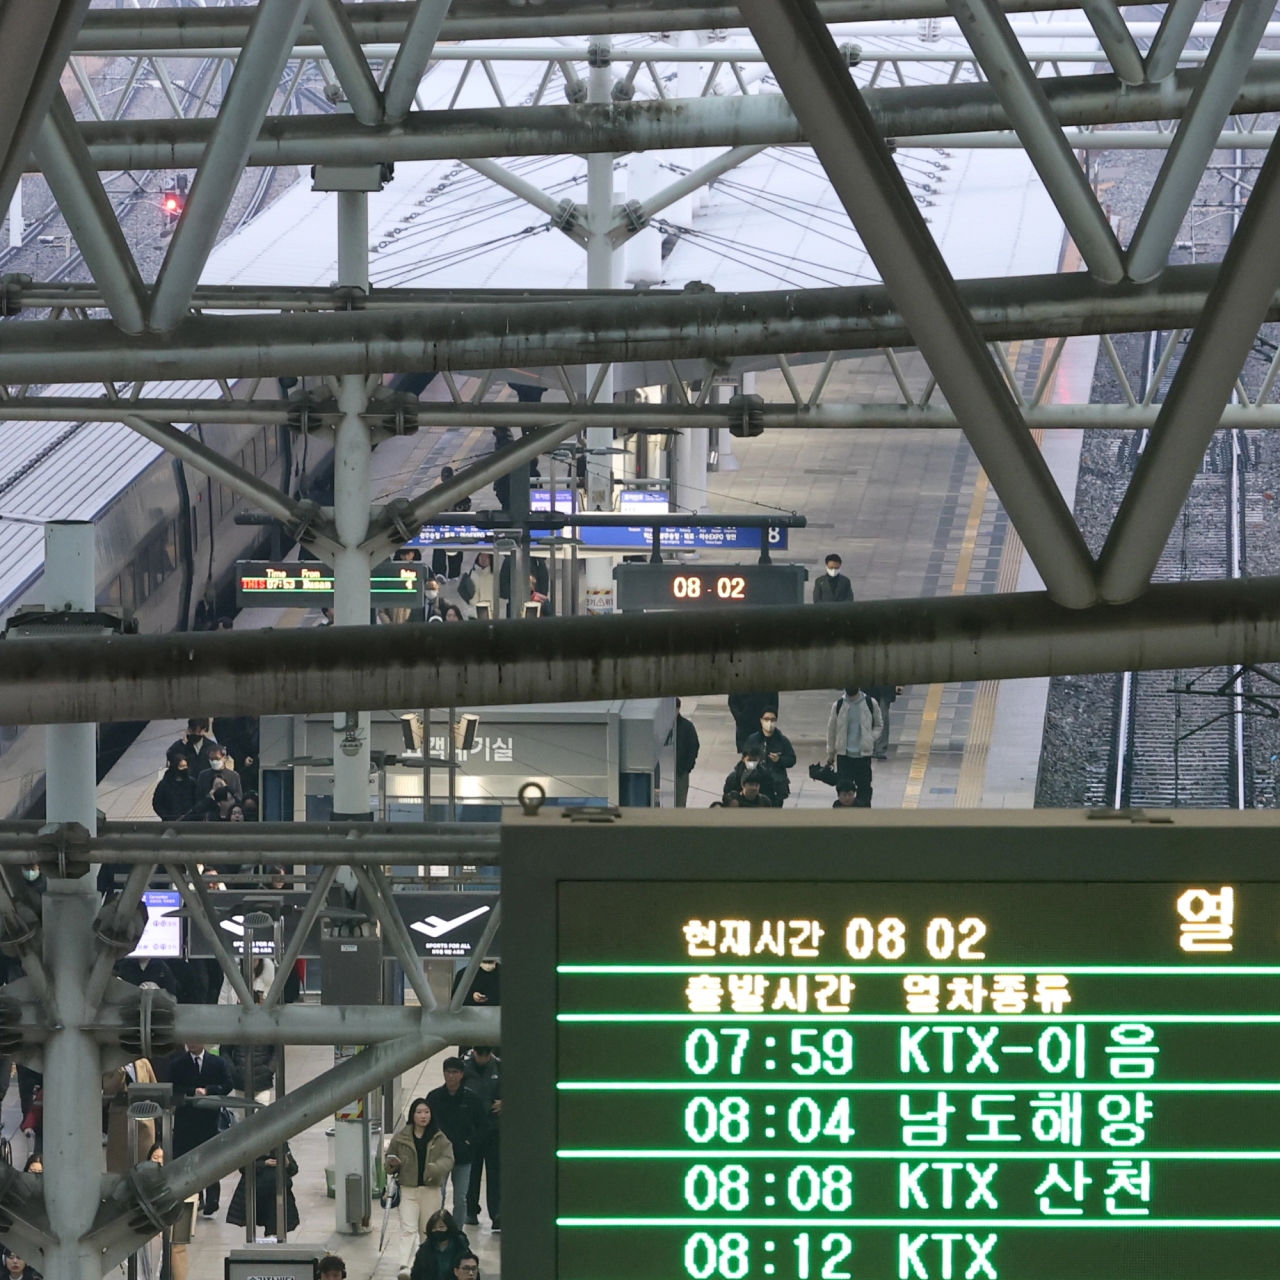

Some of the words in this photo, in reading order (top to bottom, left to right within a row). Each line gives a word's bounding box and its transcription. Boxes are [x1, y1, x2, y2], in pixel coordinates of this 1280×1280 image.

[242, 580, 265, 589] THIS
[303, 580, 331, 589] Busan
[266, 569, 286, 578] Time
[301, 569, 320, 578] From
[674, 577, 701, 598] 08
[718, 577, 745, 598] 02
[683, 919, 825, 957] 현재시간
[846, 917, 906, 960] 08
[926, 917, 986, 960] 02
[685, 973, 857, 1014] 출발시간
[903, 974, 1071, 1014] 열차종류
[685, 1028, 853, 1076] 07:59
[900, 1022, 1162, 1079] KTX-이음
[684, 1096, 855, 1144] 08:04
[899, 1091, 1153, 1147] 남도해양
[684, 1164, 852, 1212] 08:08
[899, 1161, 998, 1209] KTX
[1031, 1158, 1155, 1216] 산천
[684, 1232, 852, 1280] 08:12
[899, 1233, 997, 1280] KTX
